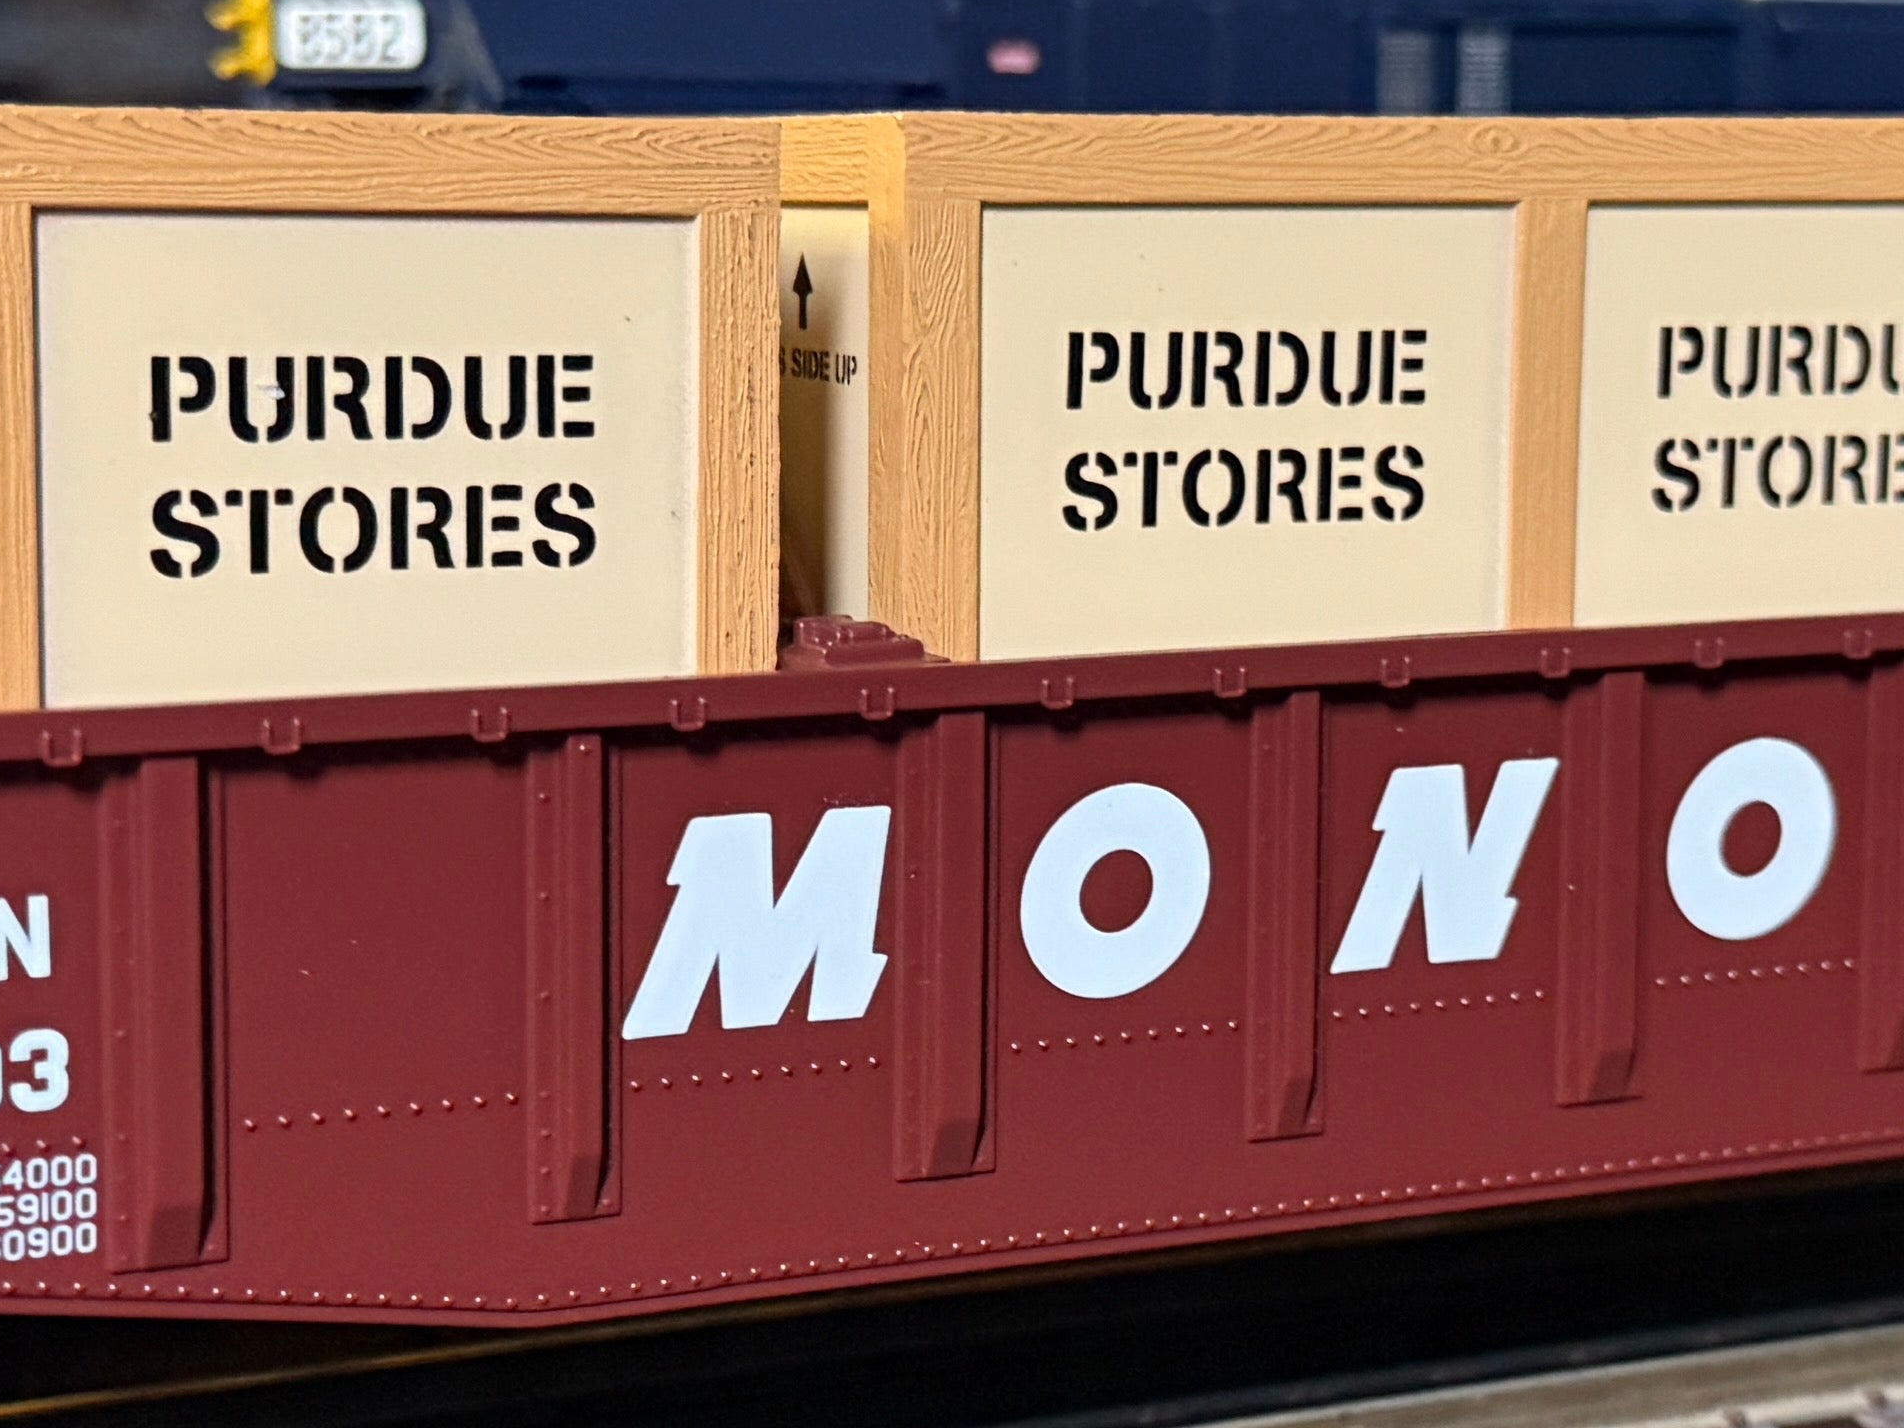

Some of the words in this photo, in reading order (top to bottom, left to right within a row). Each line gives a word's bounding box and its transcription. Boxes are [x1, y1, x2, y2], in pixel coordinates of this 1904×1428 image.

[148, 353, 596, 444] PURDUE
[790, 347, 831, 383] SIDE
[835, 353, 859, 386] UP
[1065, 328, 1428, 411] PURDUE
[149, 481, 597, 580] STORES
[1061, 444, 1425, 533] STORES
